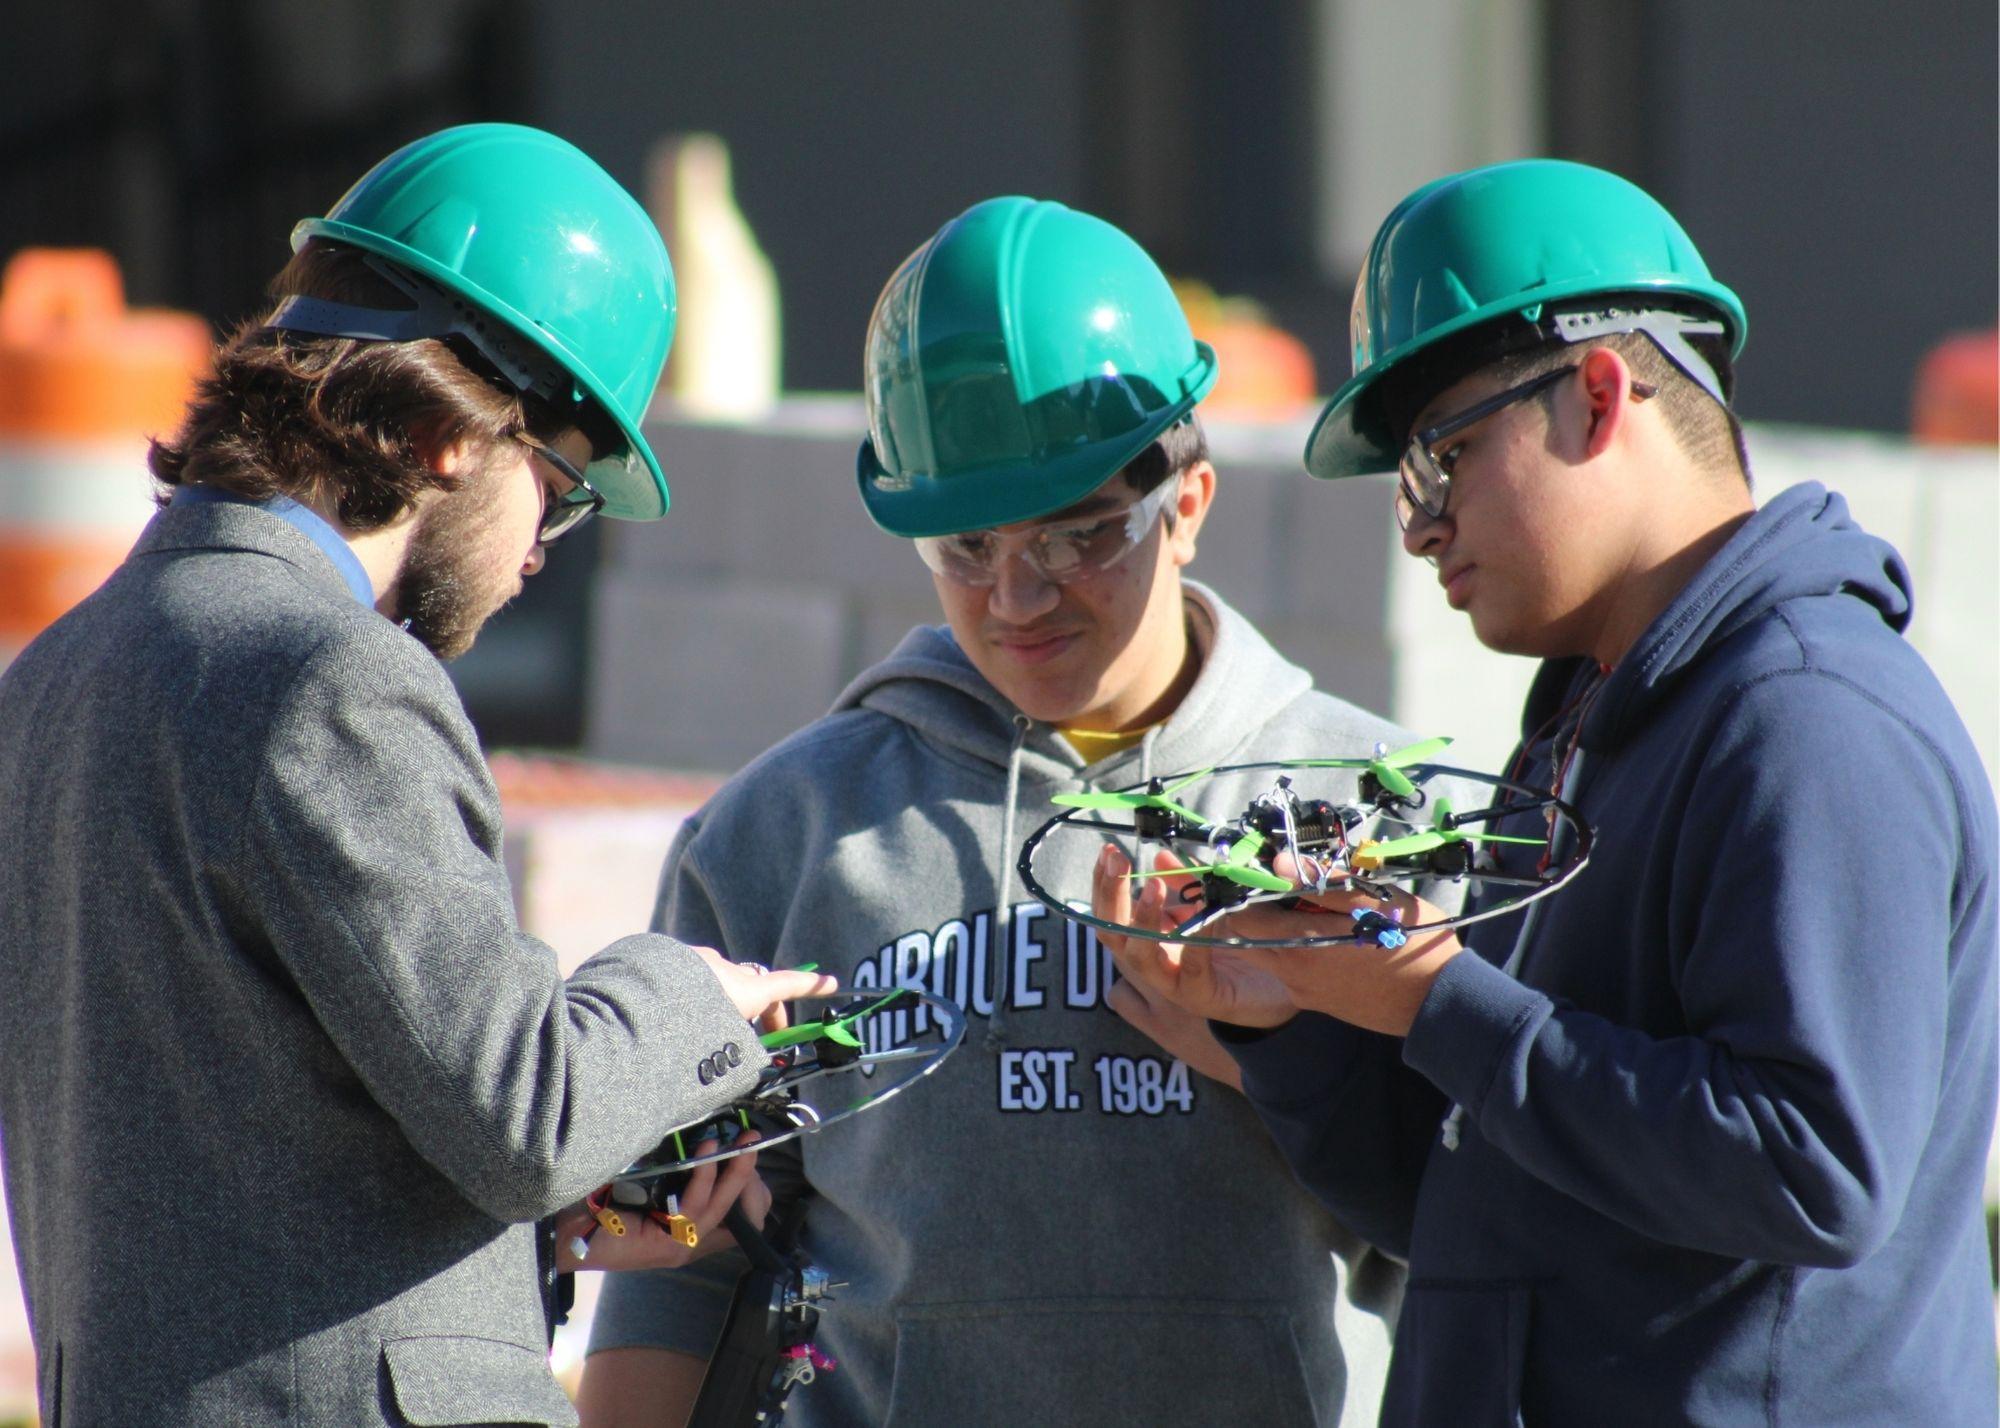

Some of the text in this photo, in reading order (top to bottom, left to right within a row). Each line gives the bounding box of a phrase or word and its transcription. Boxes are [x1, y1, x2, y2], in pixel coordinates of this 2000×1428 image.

[853, 900, 1047, 1077] CIRQUE
[997, 1047, 1194, 1115] EST. 1984
